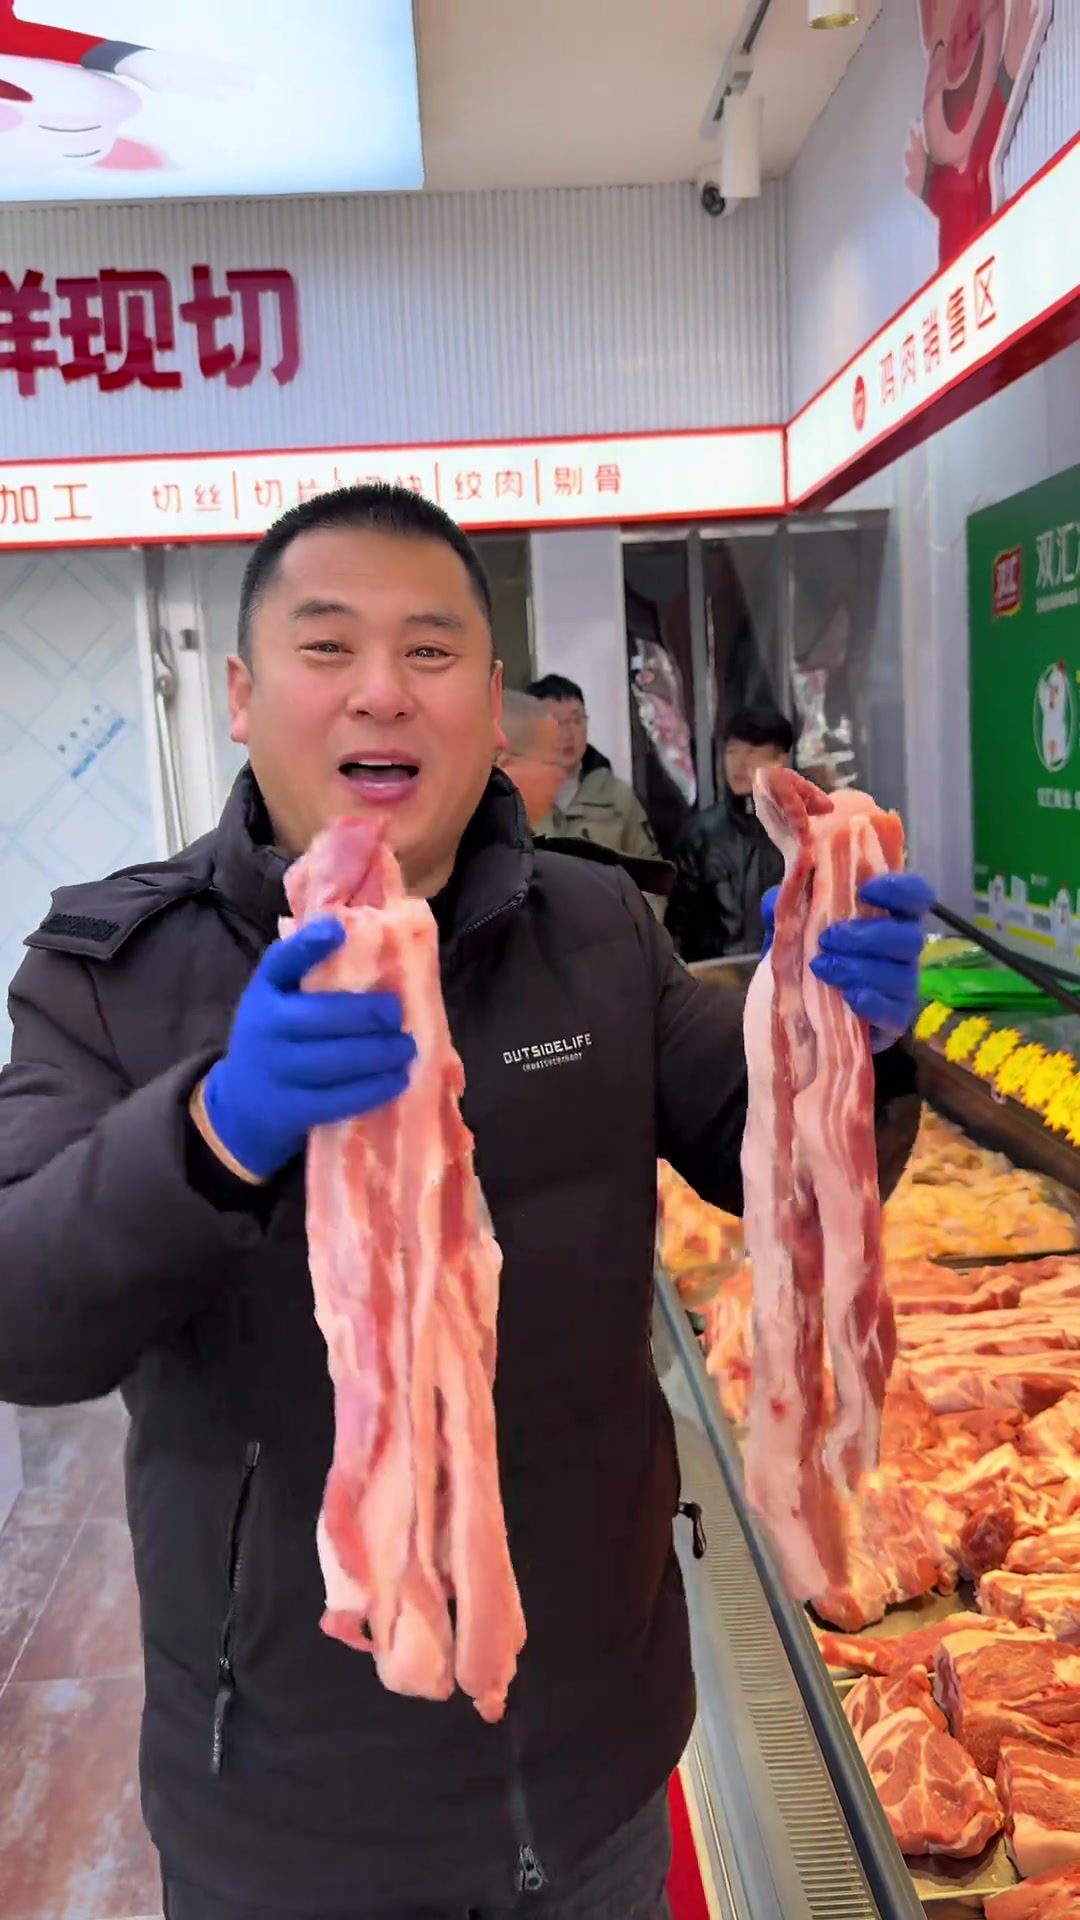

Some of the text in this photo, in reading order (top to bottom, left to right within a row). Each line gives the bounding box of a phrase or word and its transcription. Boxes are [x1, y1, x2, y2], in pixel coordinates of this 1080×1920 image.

[0, 484, 92, 525] 加工
[152, 484, 222, 513] 切丝
[455, 471, 524, 500] 绞肉
[554, 463, 621, 496] 剔骨
[1036, 523, 1080, 589] 双汇
[502, 1033, 593, 1065] OUTSIDELIFE
